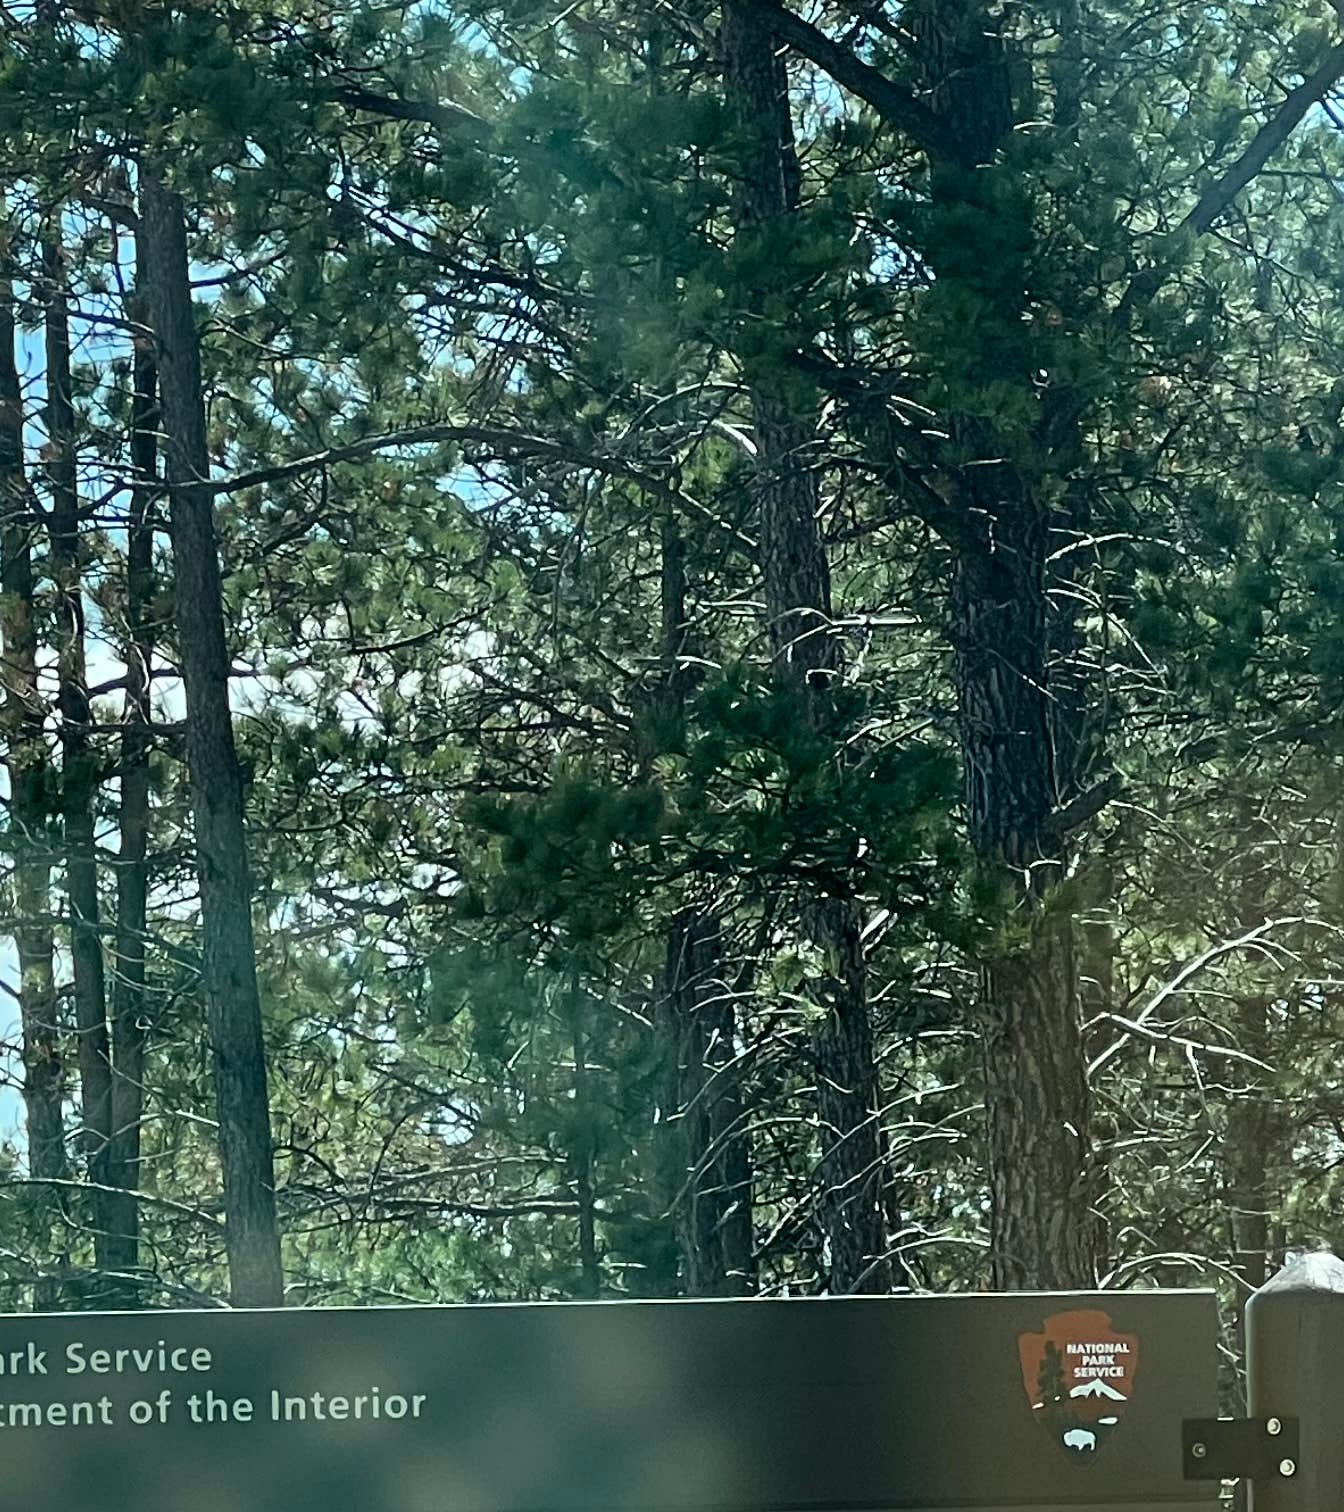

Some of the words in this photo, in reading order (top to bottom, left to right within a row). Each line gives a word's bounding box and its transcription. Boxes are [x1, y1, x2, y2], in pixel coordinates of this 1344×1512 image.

[1066, 1343, 1130, 1354] NATIONAL
[65, 1340, 213, 1375] Service
[1082, 1355, 1115, 1366] PARK
[1073, 1366, 1124, 1378] SERVICE
[129, 1390, 172, 1424] of
[187, 1390, 254, 1423] the
[271, 1386, 427, 1422] Interior
